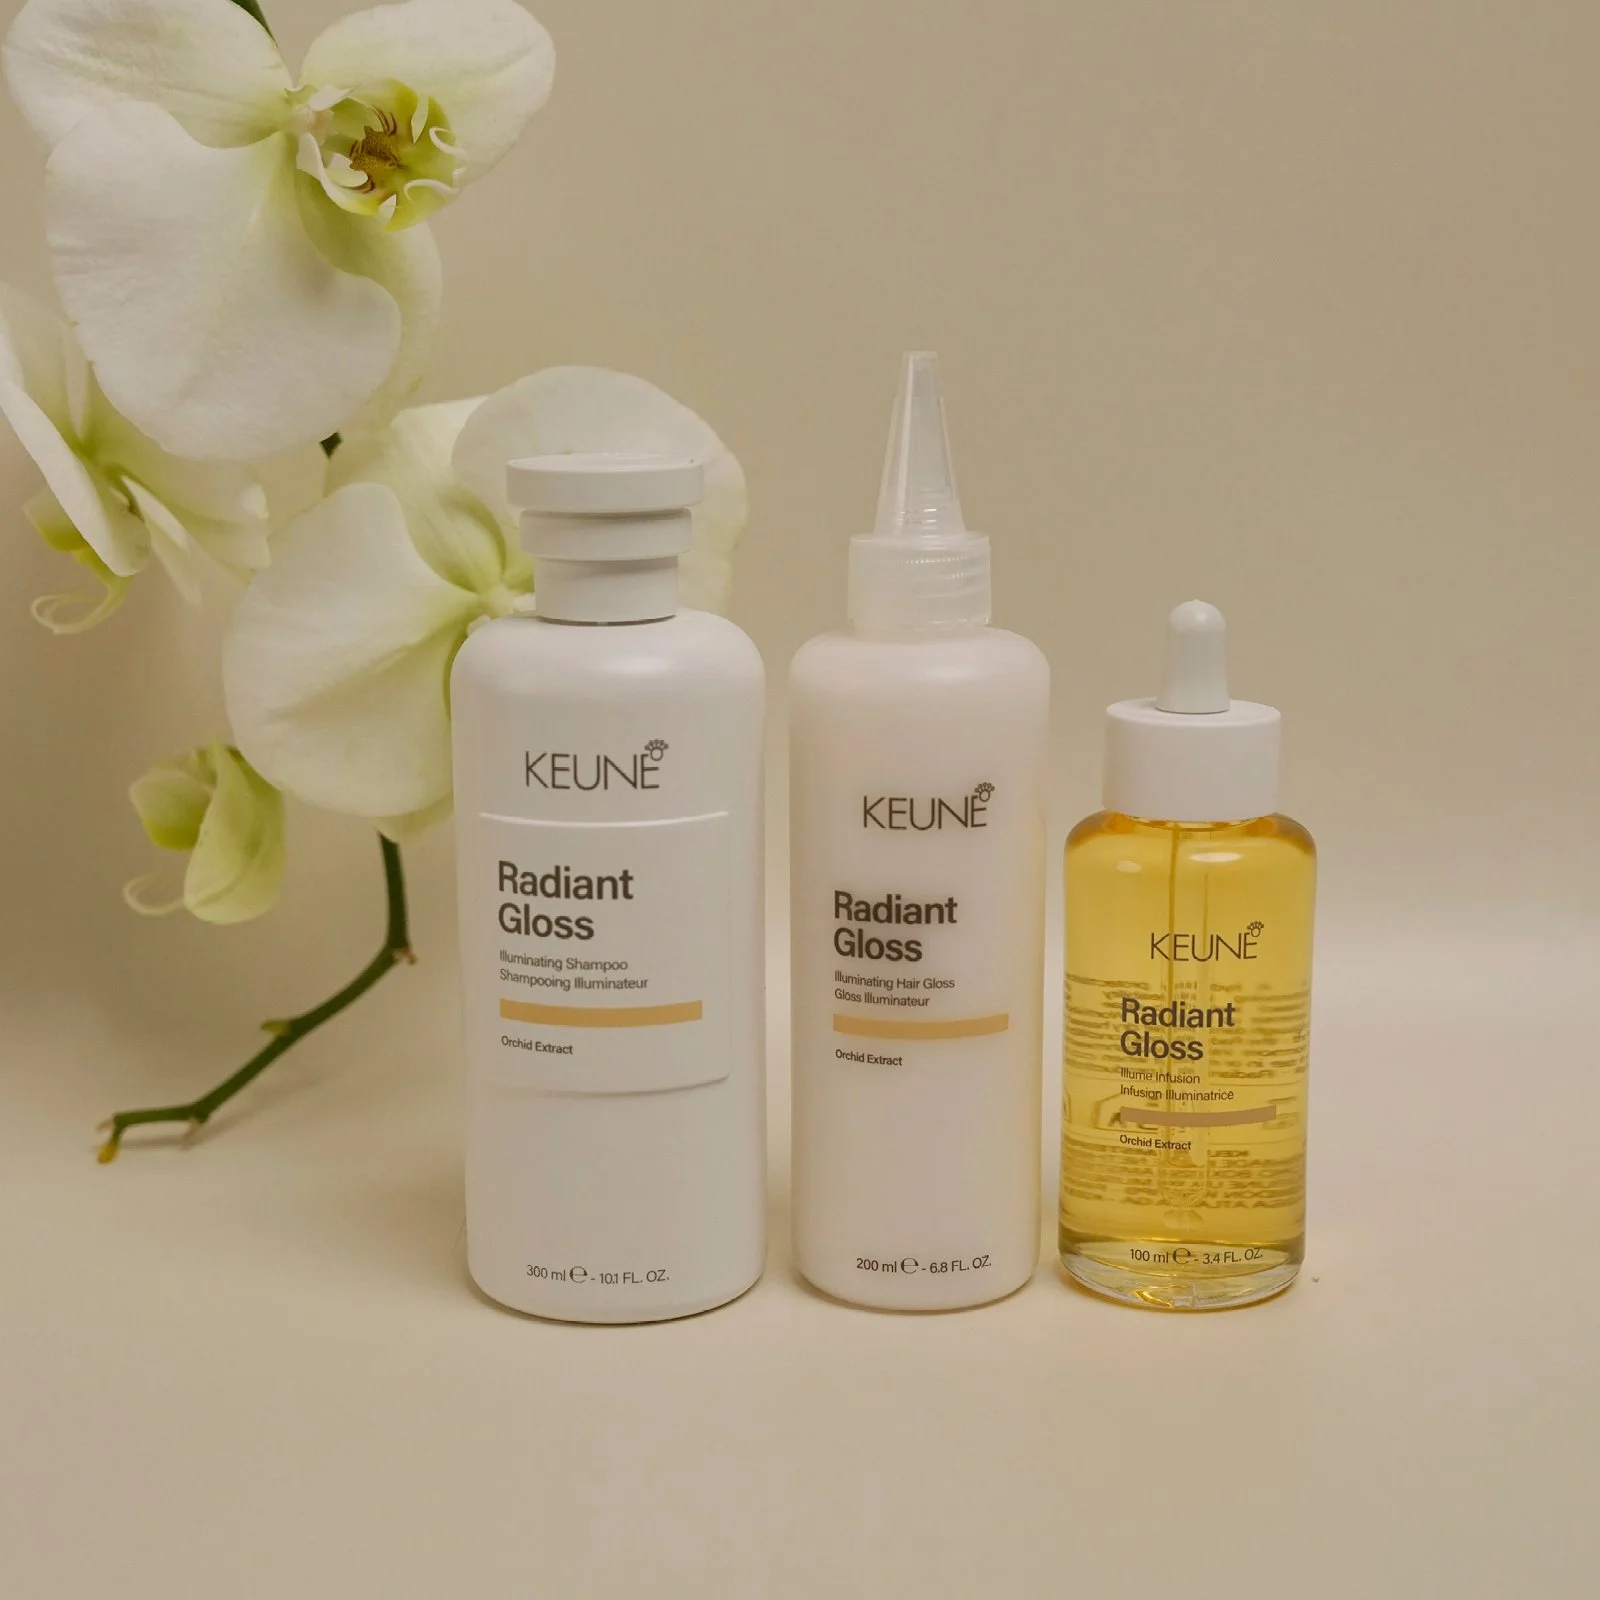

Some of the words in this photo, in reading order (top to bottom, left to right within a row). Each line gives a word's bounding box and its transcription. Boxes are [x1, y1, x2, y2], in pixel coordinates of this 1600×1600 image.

[525, 750, 660, 791] KEUNE
[863, 795, 987, 830] KEUNE
[498, 860, 634, 900] Radiant
[834, 890, 958, 925] Radiant
[498, 902, 595, 940] Gloss
[833, 927, 923, 962] Gloss
[1151, 932, 1258, 962] KEUNE
[499, 950, 563, 971] Illuminating
[566, 957, 629, 973] Shampoo
[499, 968, 571, 991] Shampooing
[574, 977, 649, 990] Illuminateur
[834, 970, 894, 991] Illuminating
[897, 976, 920, 989] Hair
[923, 977, 956, 990] Gloss
[834, 988, 862, 1002] Gloss
[864, 992, 931, 1007] Illuminateur
[1121, 997, 1236, 1028] Radiant
[501, 1036, 533, 1050] Orchid
[535, 1041, 574, 1055] Extract
[1120, 1030, 1204, 1061] Gloss
[835, 1049, 865, 1064] Orchid
[867, 1053, 903, 1066] Extract
[1120, 1067, 1153, 1081] Illume
[1155, 1070, 1201, 1084] Infusion
[1120, 1084, 1162, 1101] Infusion
[1165, 1089, 1234, 1102] Illuminatrice
[1119, 1134, 1153, 1148] Orchid
[1154, 1138, 1192, 1151] Extract
[856, 1257, 879, 1272] 200
[882, 1261, 897, 1273] ml
[929, 1261, 948, 1274] 6.8
[951, 1259, 970, 1272] FL.
[972, 1254, 992, 1270] OZ.
[1130, 1248, 1150, 1263] 100
[1153, 1252, 1169, 1265] ml
[1202, 1251, 1221, 1265] 3.4
[1223, 1248, 1242, 1264] FL.
[1244, 1247, 1264, 1262] OZ.
[526, 1264, 548, 1279] 300
[551, 1269, 566, 1282] ml
[599, 1272, 619, 1284] 10.1
[622, 1271, 643, 1284] FL.
[646, 1269, 670, 1283] OZ.
